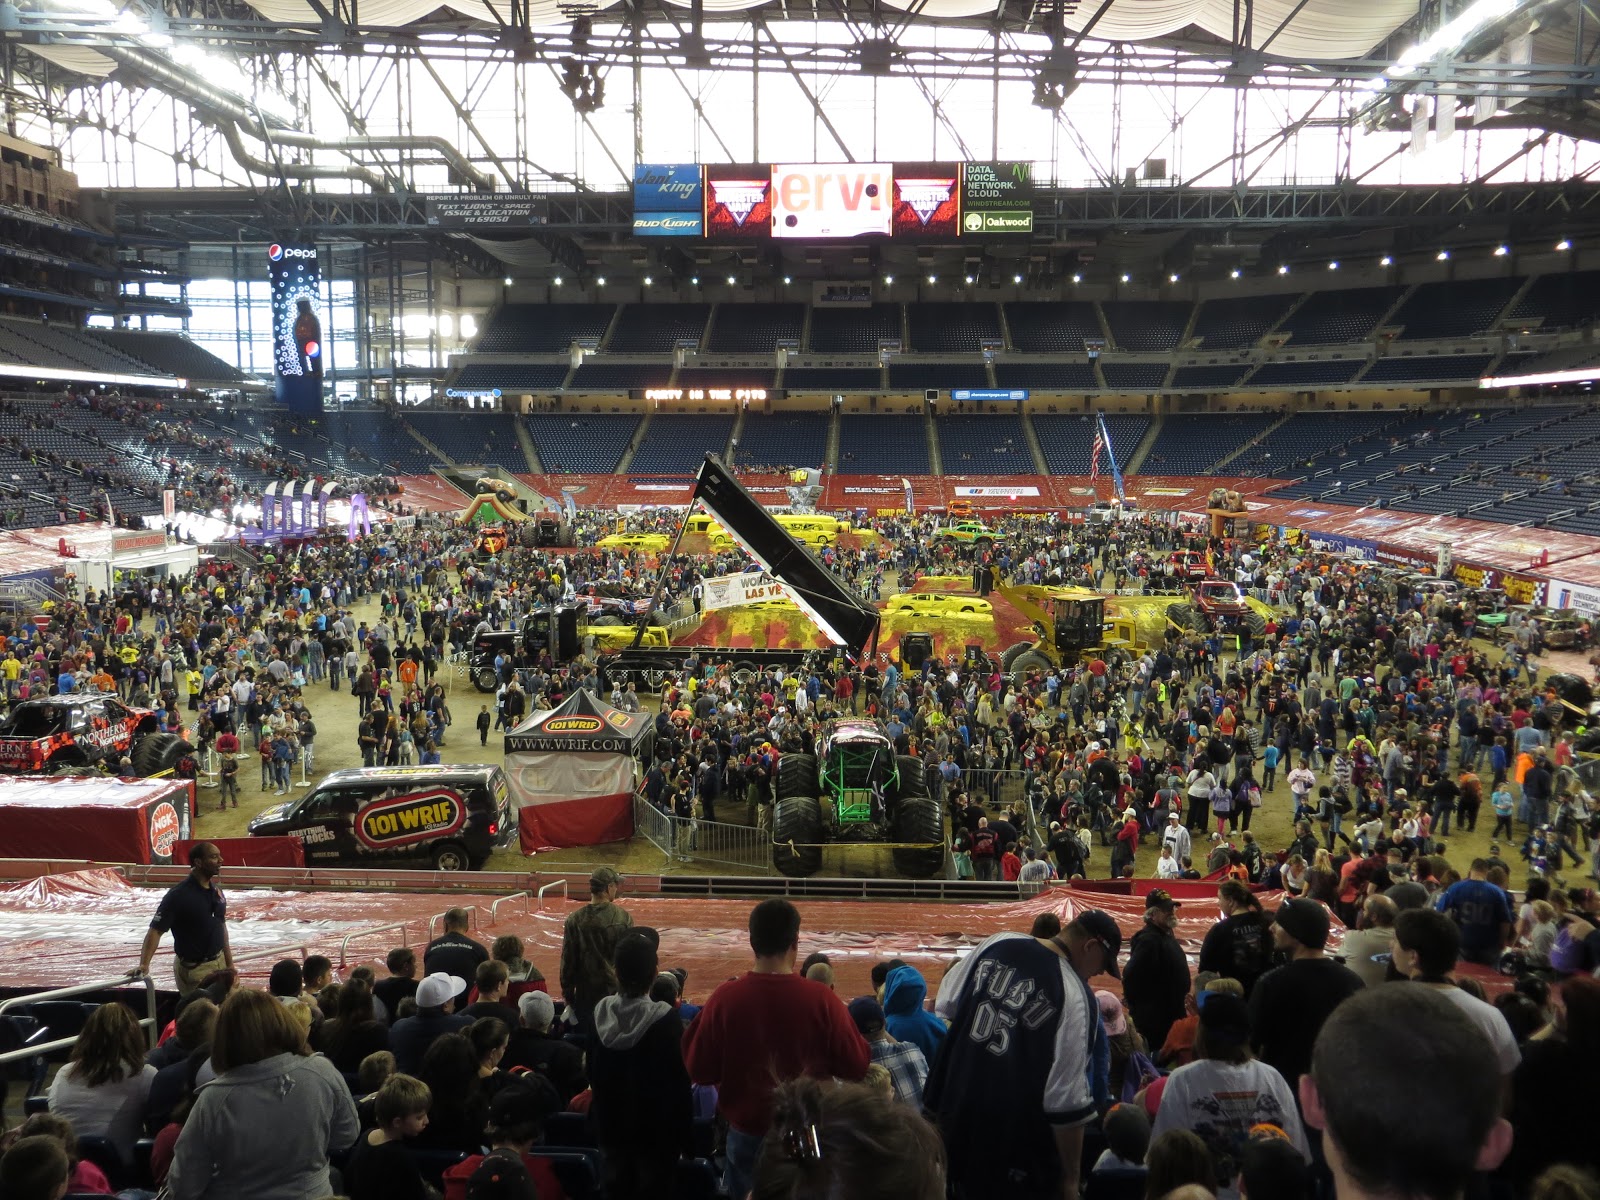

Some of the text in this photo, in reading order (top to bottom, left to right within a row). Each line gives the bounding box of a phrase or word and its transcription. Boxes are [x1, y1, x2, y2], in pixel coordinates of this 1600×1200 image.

[967, 166, 994, 174] DATA.
[967, 174, 999, 182] VOICE.
[967, 182, 1017, 190] NETWORK.
[967, 190, 1003, 198] CLOUD.
[986, 217, 1029, 227] Oakwood
[284, 248, 317, 259] pepsi
[877, 508, 895, 517] SHOP
[745, 587, 765, 600] LAS
[550, 720, 598, 729] 101 WRIF
[82, 722, 127, 746] NORTHERN
[509, 737, 627, 751] WWW.WRIF.COM
[154, 811, 173, 833] NGK
[367, 801, 451, 837] 101 WRIF
[433, 821, 449, 830] Radio
[306, 830, 336, 845] ROCKS
[973, 958, 1057, 1031] FUBU
